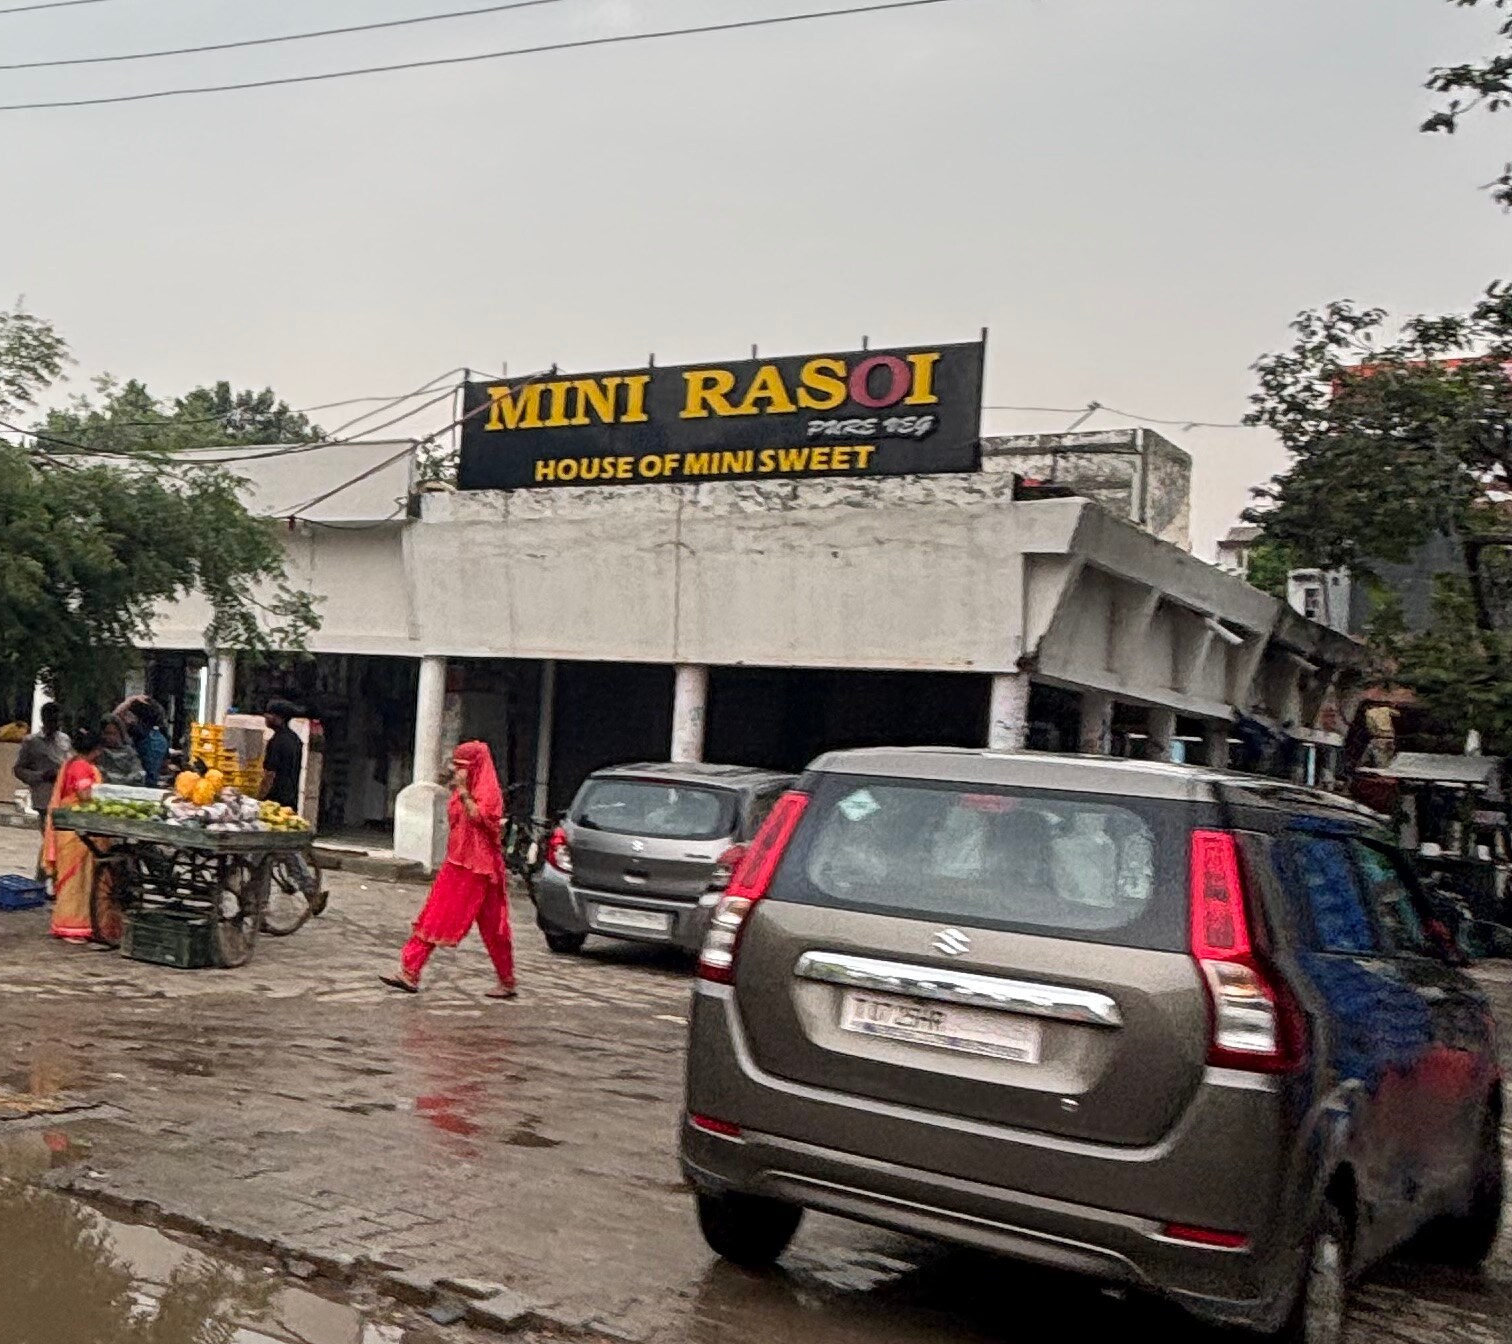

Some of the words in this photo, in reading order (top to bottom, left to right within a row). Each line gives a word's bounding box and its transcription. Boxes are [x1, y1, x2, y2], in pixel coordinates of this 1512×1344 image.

[484, 374, 650, 431] MINI
[679, 352, 940, 419] RASOI
[534, 456, 634, 482] HOUSE
[638, 454, 679, 478] OF
[682, 450, 755, 476] MINI
[758, 445, 875, 473] SWEET
